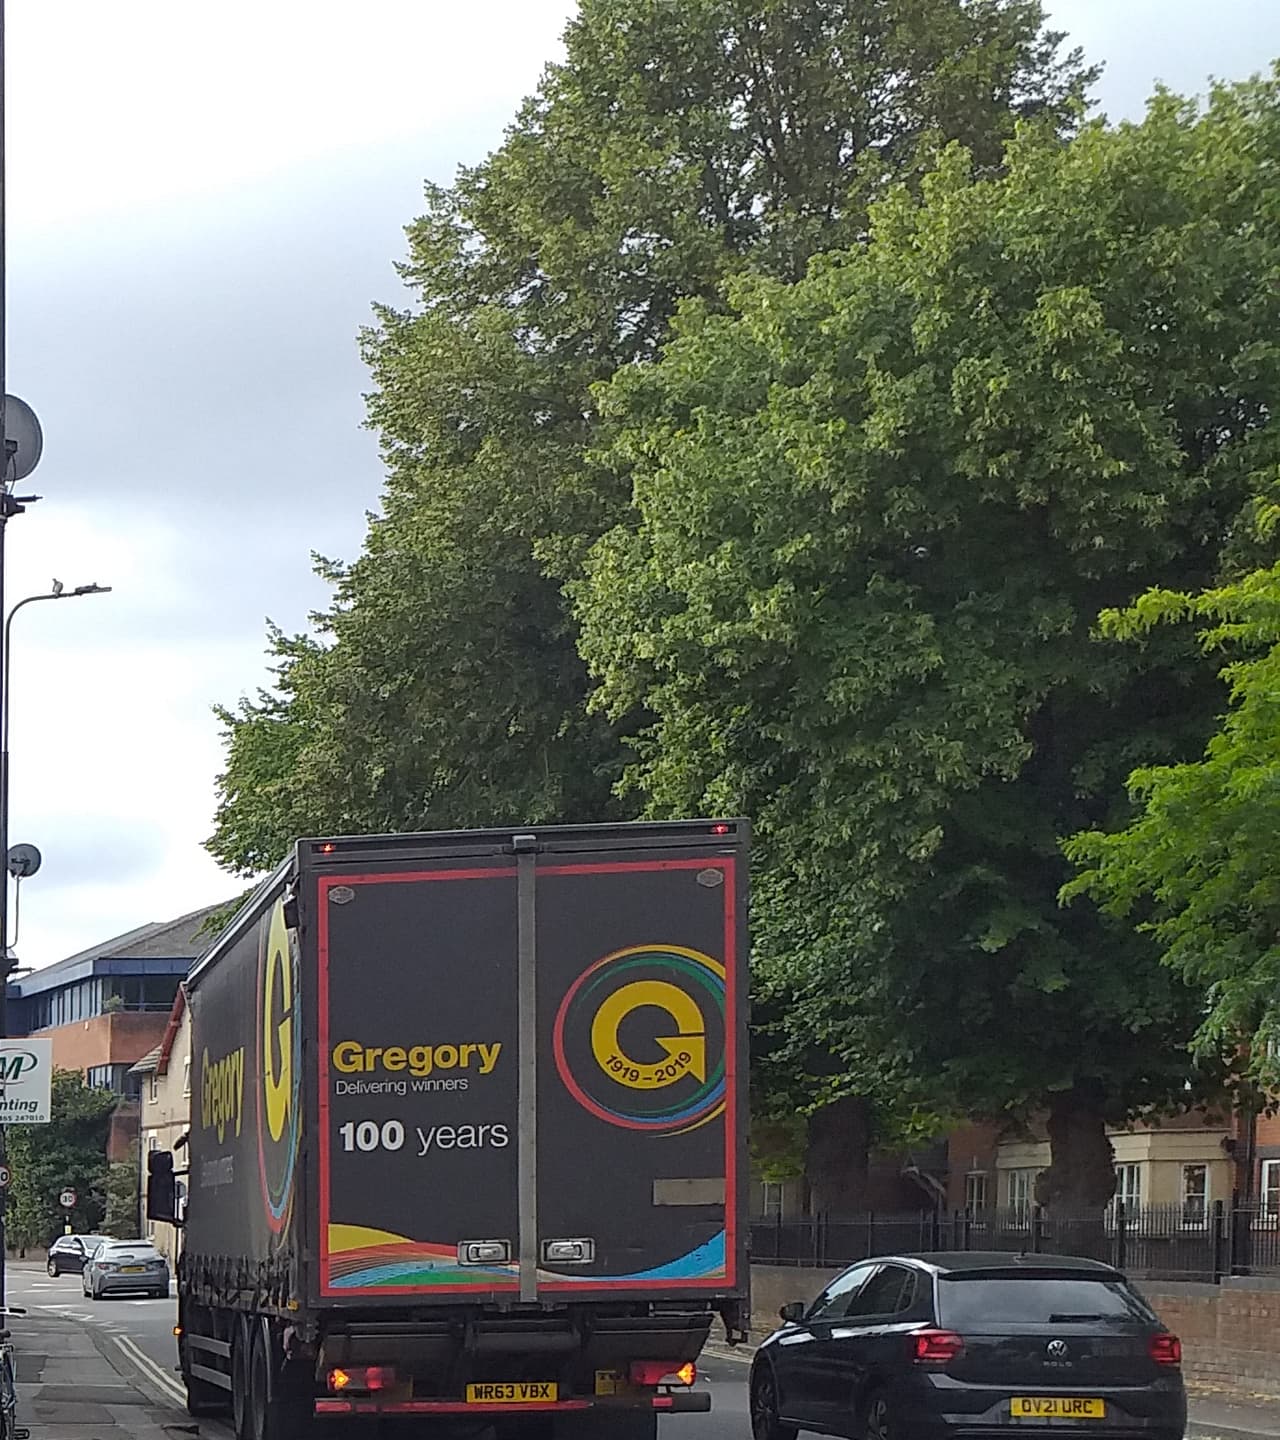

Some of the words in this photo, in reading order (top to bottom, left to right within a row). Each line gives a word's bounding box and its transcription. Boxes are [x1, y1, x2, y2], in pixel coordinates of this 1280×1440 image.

[333, 1041, 502, 1077] Gregory
[201, 1047, 244, 1144] Gregory
[336, 1078, 407, 1096] Delivering
[411, 1078, 469, 1092] winners
[340, 1120, 405, 1152] 100
[417, 1123, 509, 1156] years
[474, 1385, 515, 1399] WR63
[519, 1384, 550, 1398] VBX
[1062, 1400, 1093, 1414] URC
